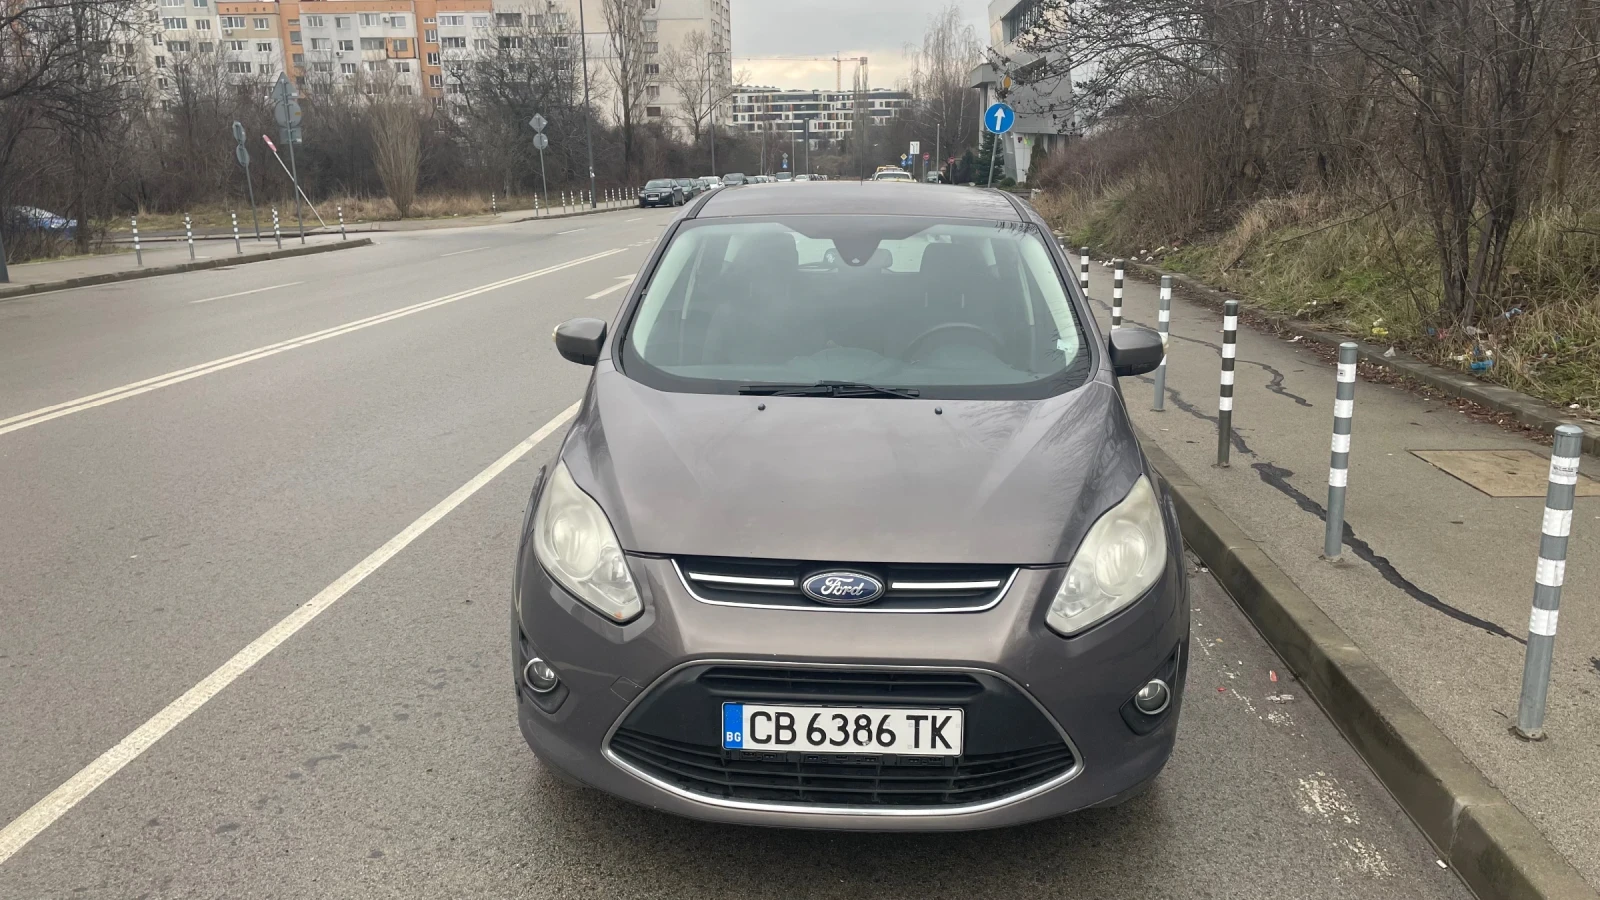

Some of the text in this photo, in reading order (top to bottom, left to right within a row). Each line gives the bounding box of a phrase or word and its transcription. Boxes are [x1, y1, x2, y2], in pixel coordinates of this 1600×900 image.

[820, 576, 865, 596] Ford
[726, 731, 741, 742] BG
[749, 710, 953, 749] CB 6386 TK
